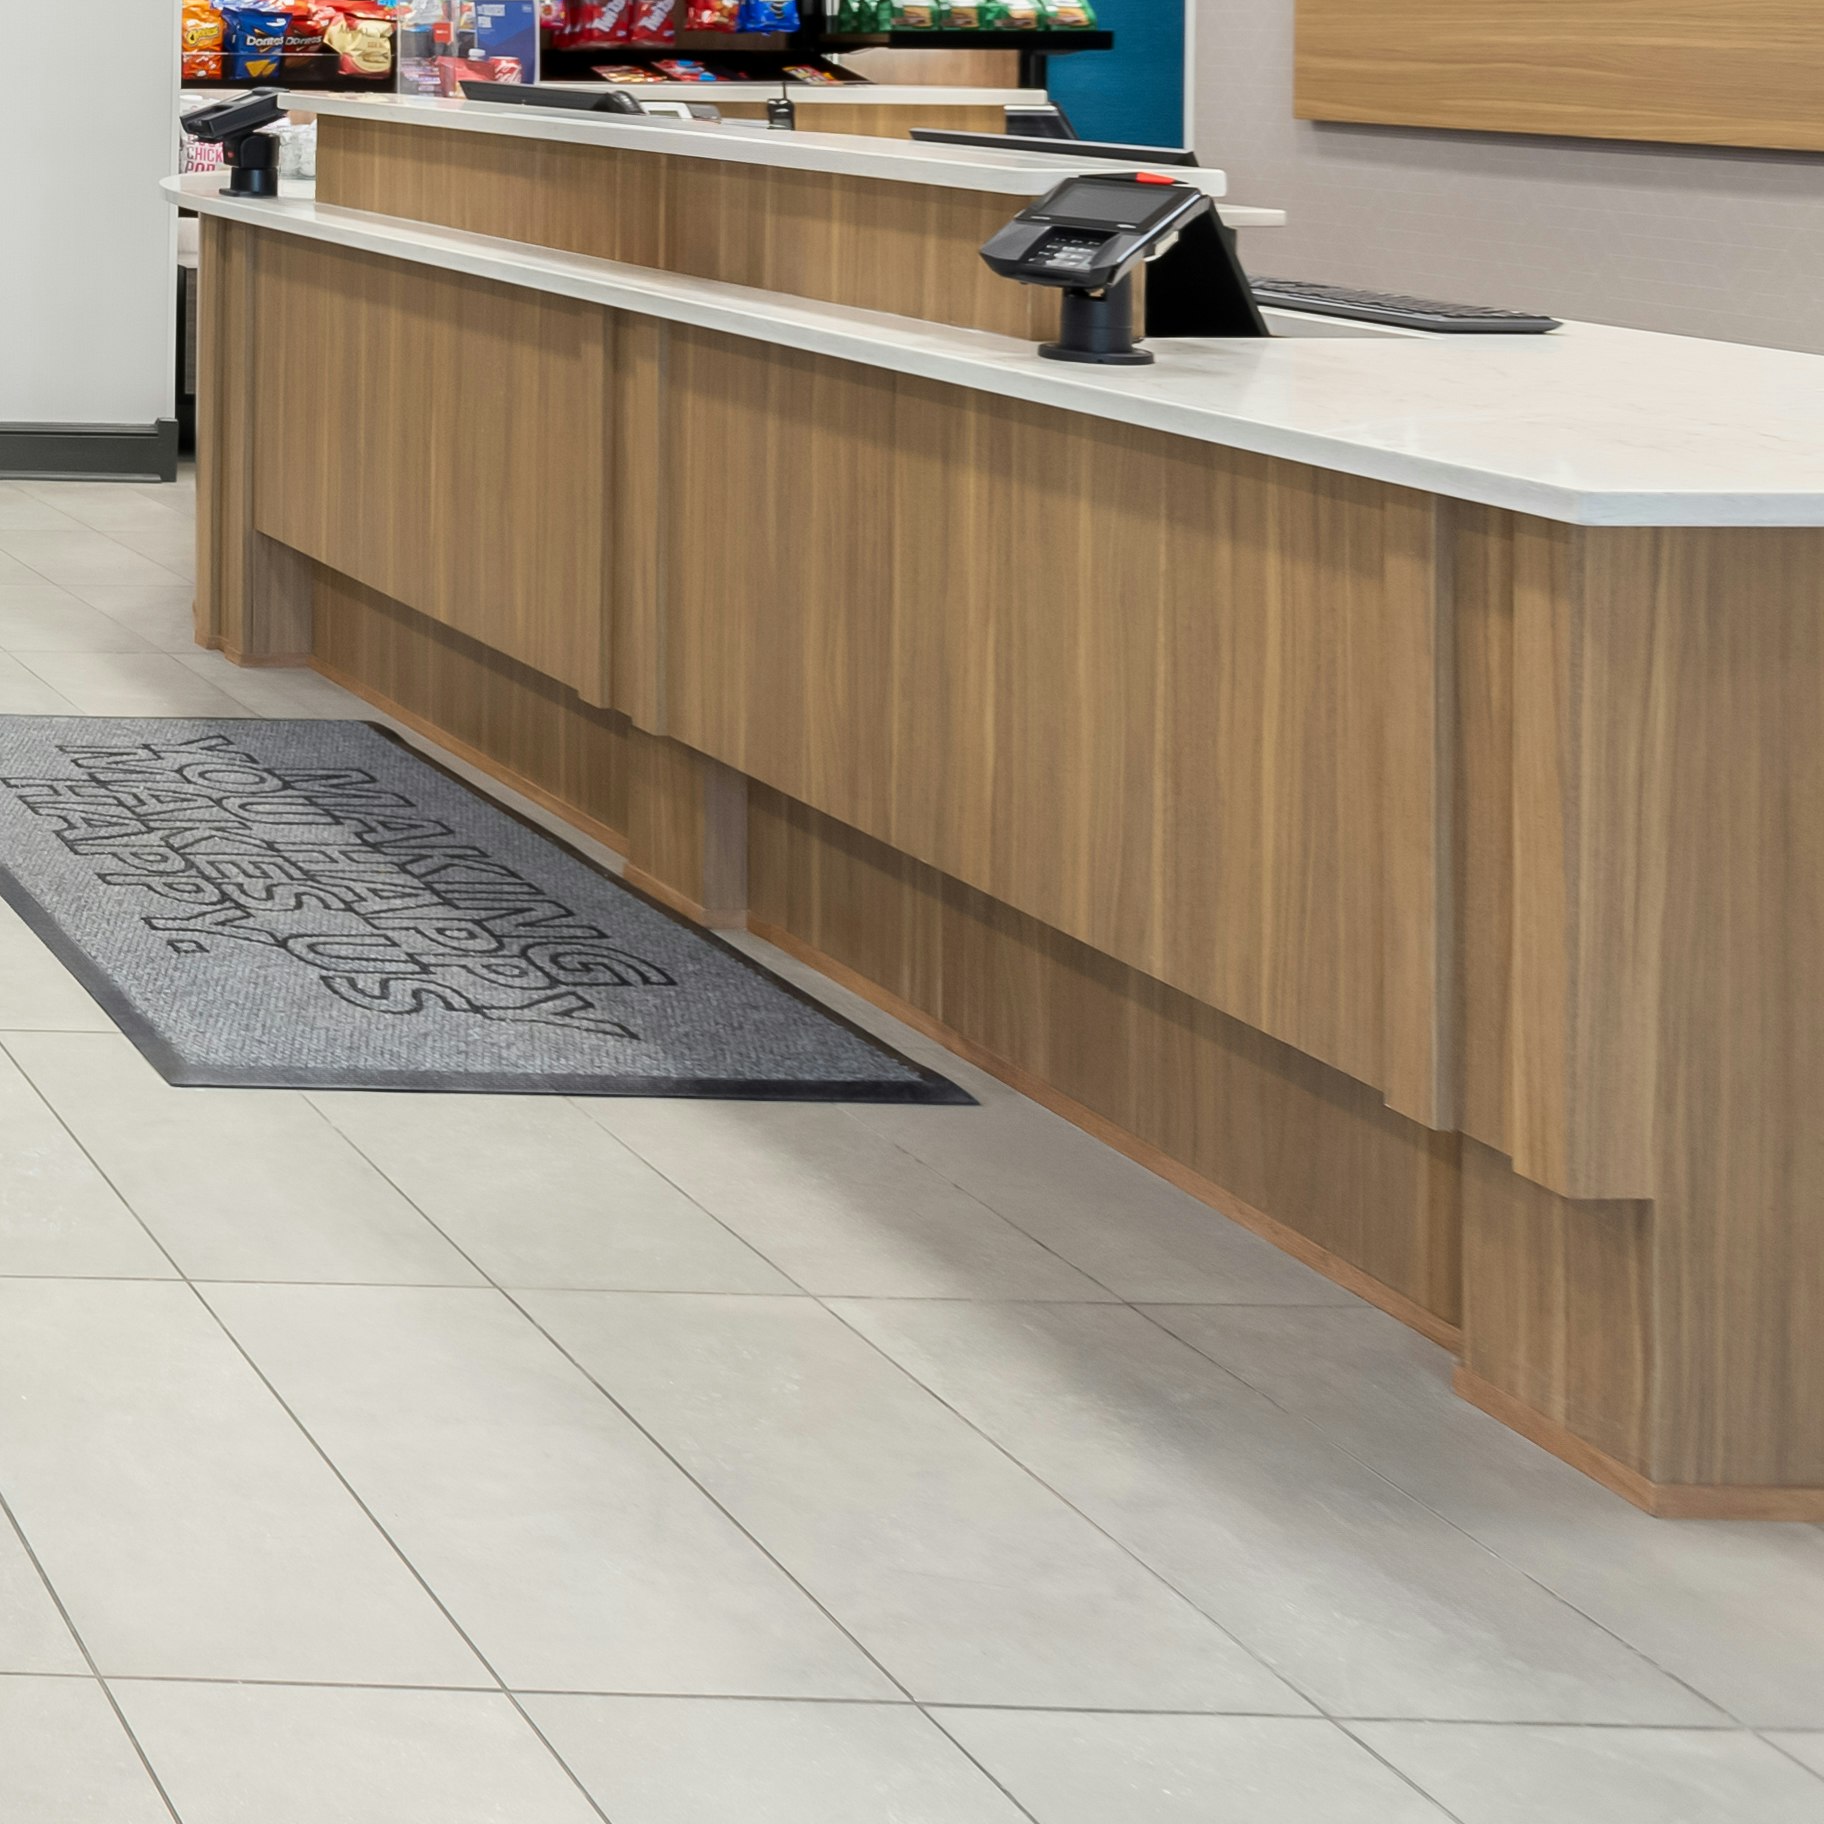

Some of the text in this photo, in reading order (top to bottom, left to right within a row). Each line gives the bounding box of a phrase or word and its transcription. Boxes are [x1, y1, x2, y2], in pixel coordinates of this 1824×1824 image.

[246, 35, 284, 46] Doritos
[285, 35, 322, 46] Doritos
[54, 744, 480, 1015] MAKES US
[140, 734, 642, 1041] YOU HAPPY
[263, 766, 678, 987] MAKING
